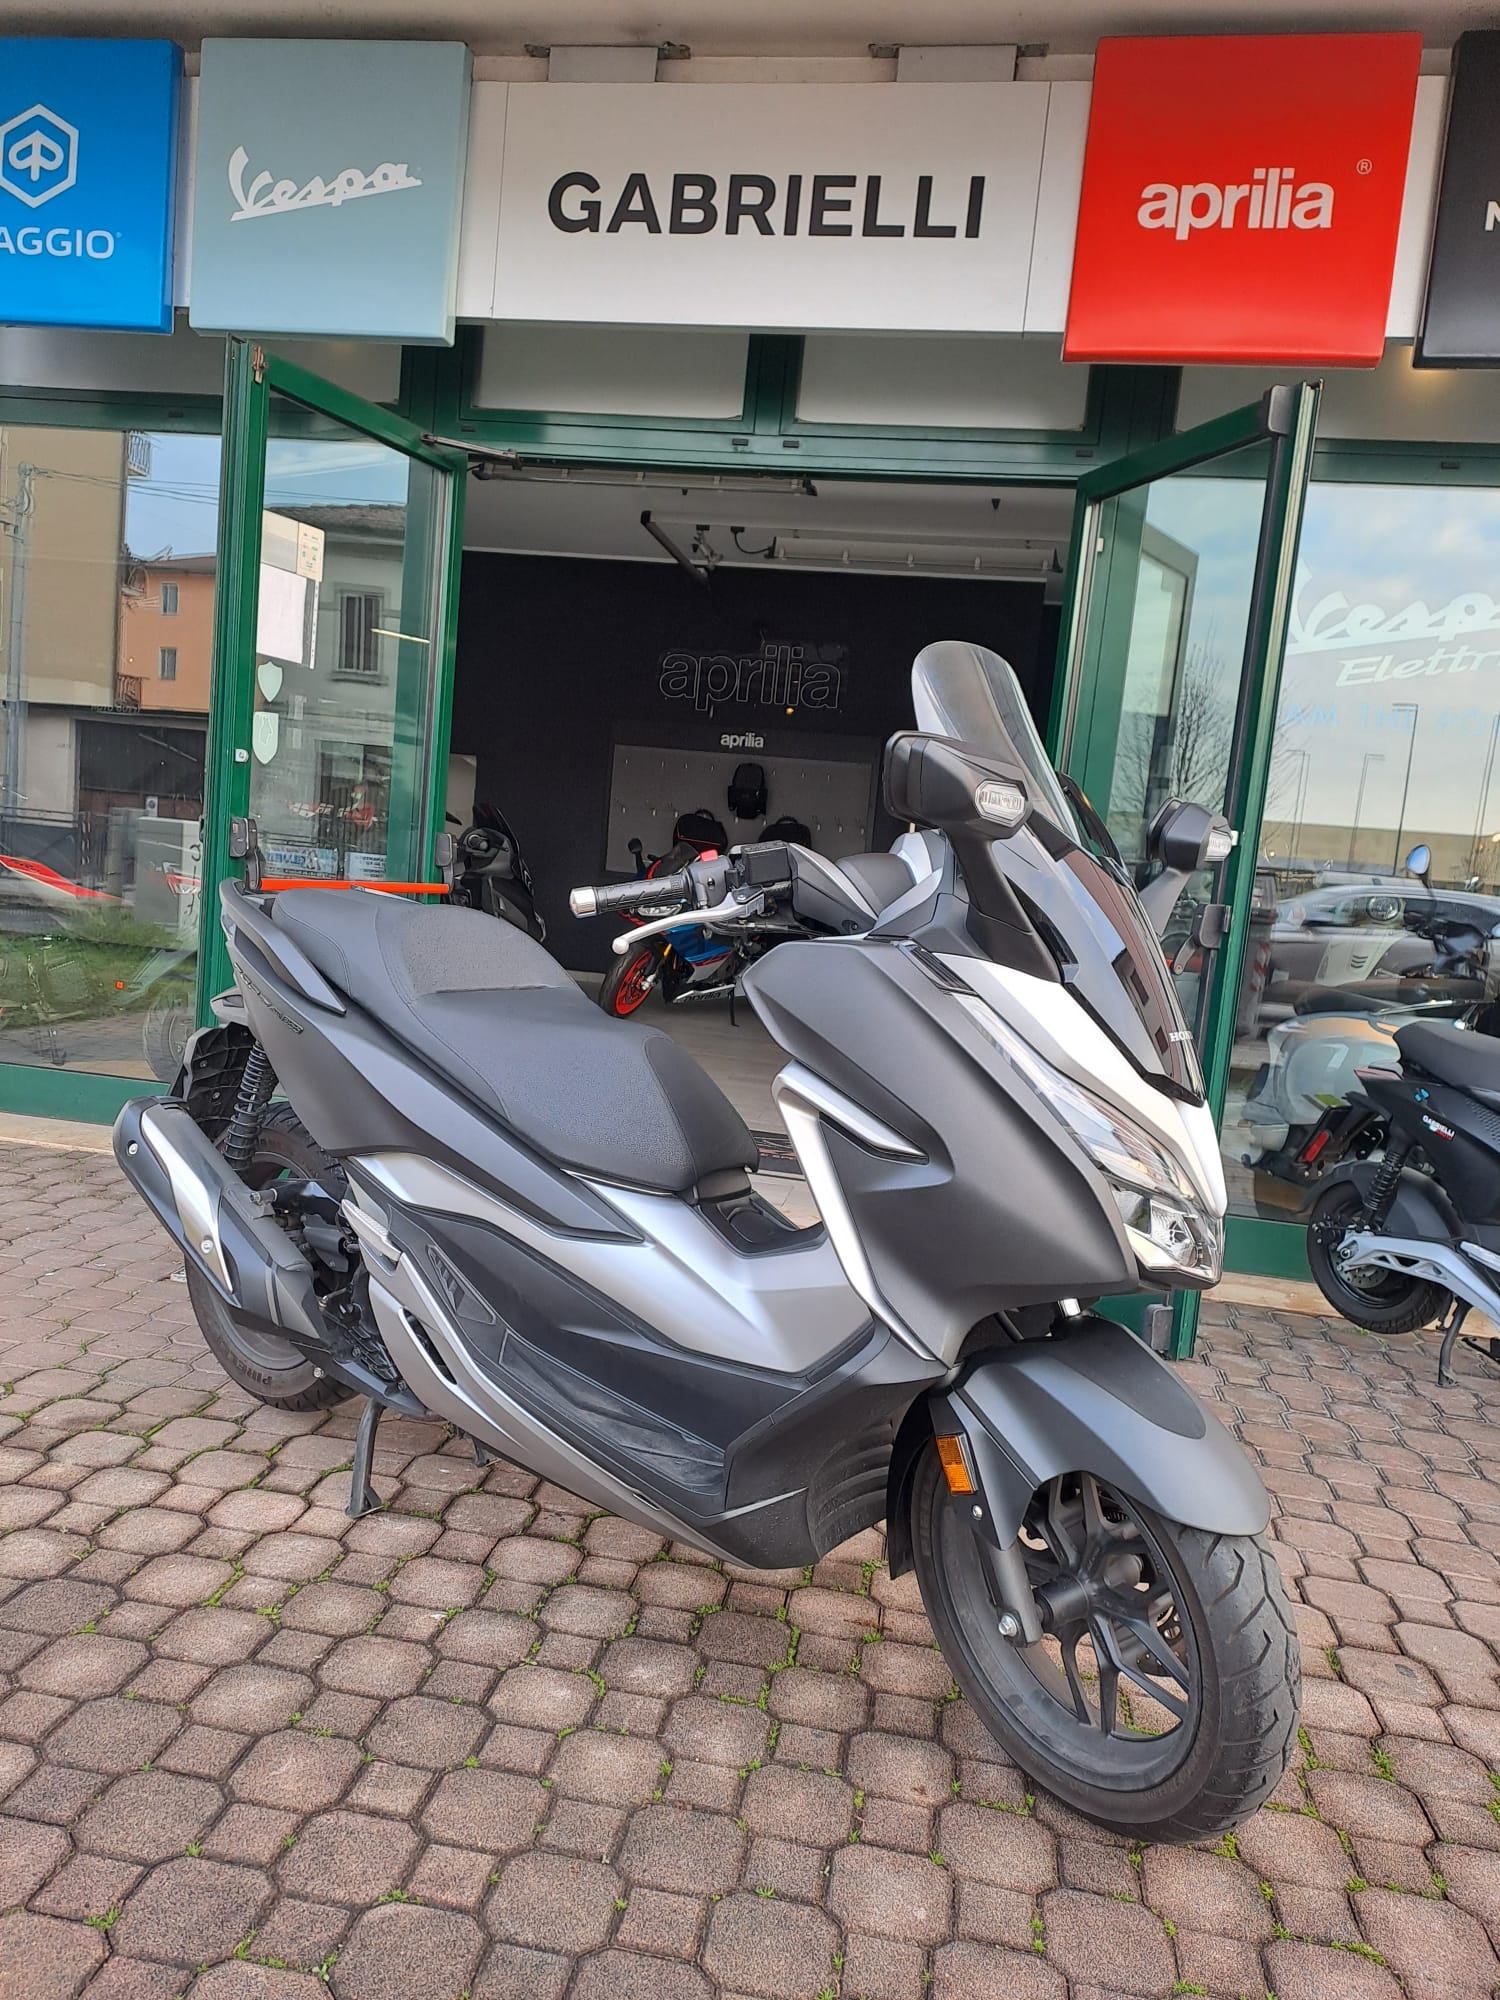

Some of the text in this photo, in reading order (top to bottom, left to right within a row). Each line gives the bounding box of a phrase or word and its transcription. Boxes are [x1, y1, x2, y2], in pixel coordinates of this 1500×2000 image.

[228, 145, 423, 222] Vespa
[548, 171, 986, 239] GABRIELLI
[1137, 167, 1335, 240] aprilia
[1286, 557, 1500, 656] Vesp
[659, 645, 841, 711] aprilia
[1335, 645, 1500, 688] Elettr
[720, 732, 764, 749] aprilia
